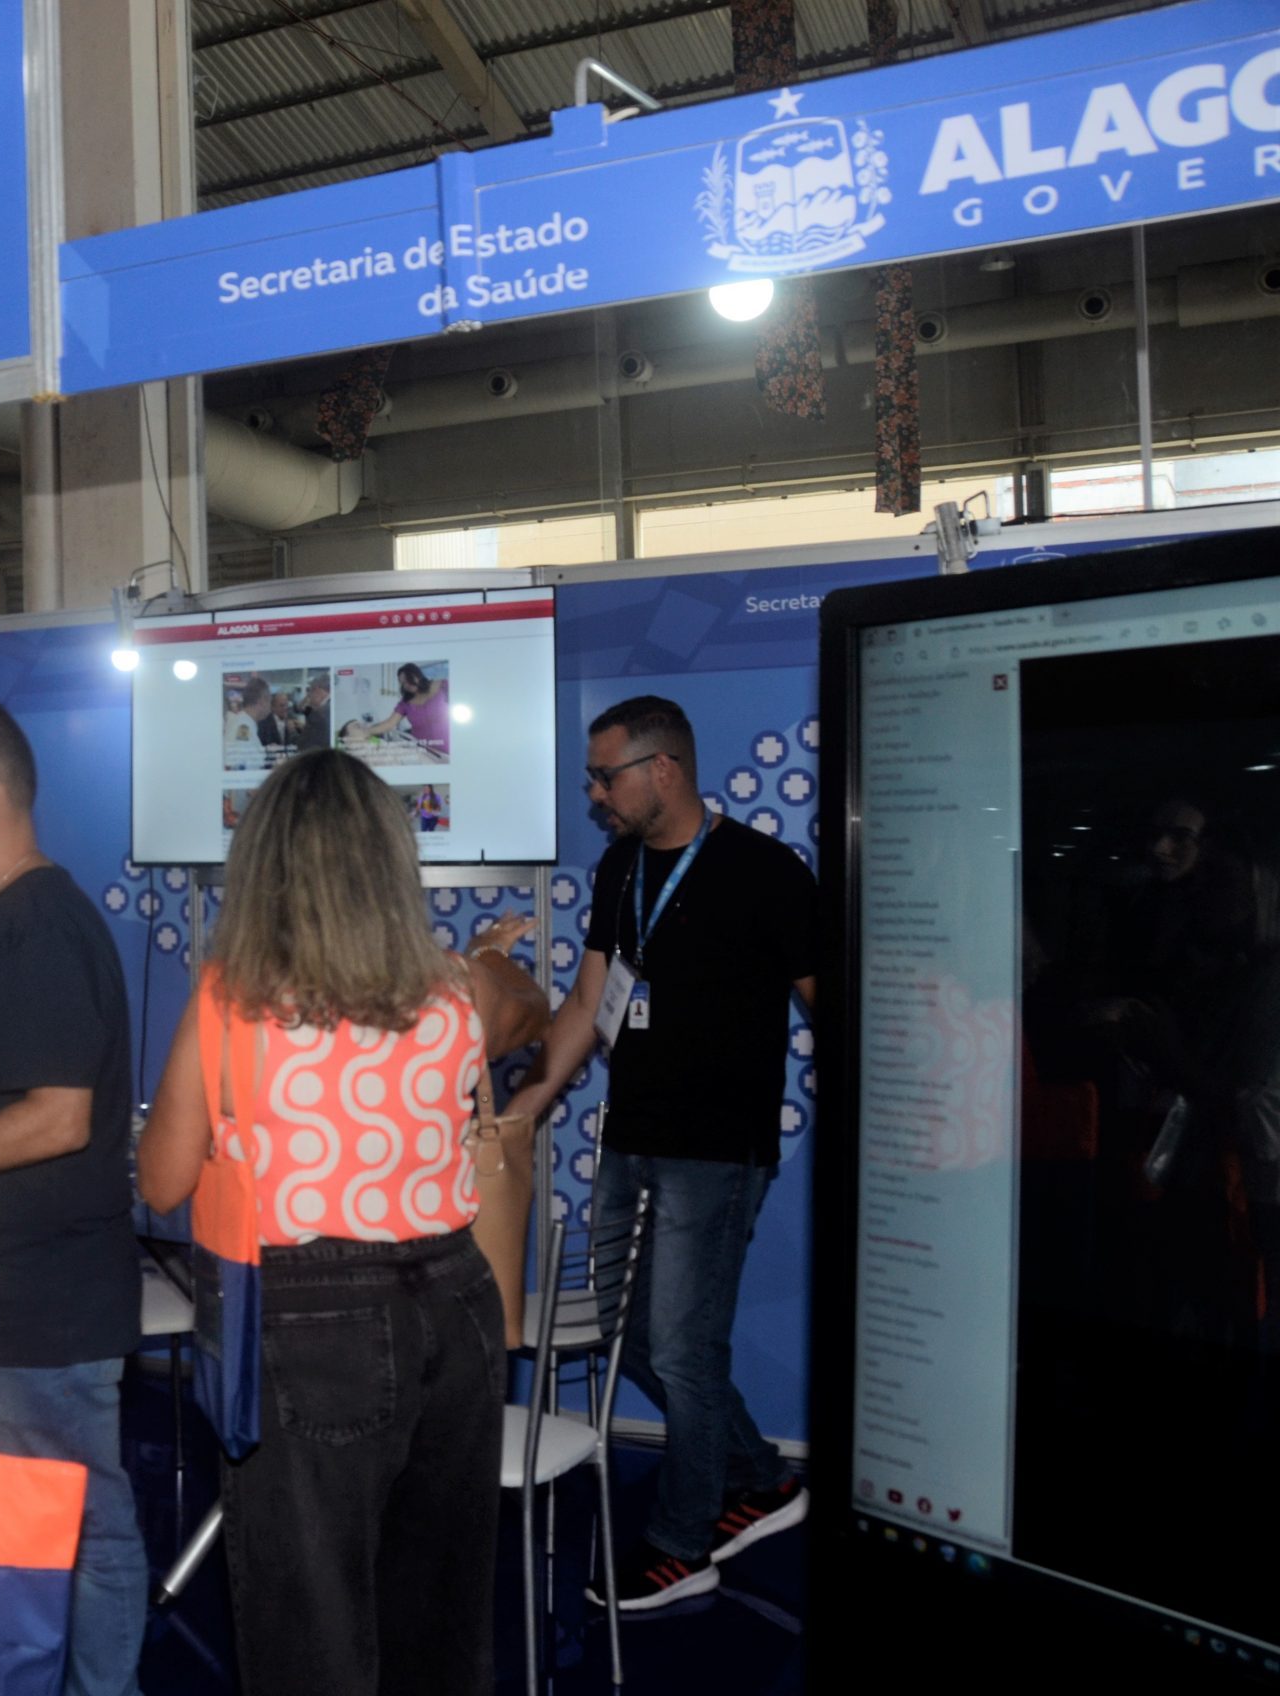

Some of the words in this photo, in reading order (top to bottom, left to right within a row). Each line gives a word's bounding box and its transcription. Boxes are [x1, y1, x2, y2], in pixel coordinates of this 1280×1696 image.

[219, 246, 396, 303] Secretaria
[404, 236, 444, 270] de
[450, 211, 589, 259] Estado
[419, 283, 459, 316] da
[466, 262, 589, 308] Saúde
[746, 593, 826, 613] Secreta
[217, 623, 260, 636] ALAGOAS
